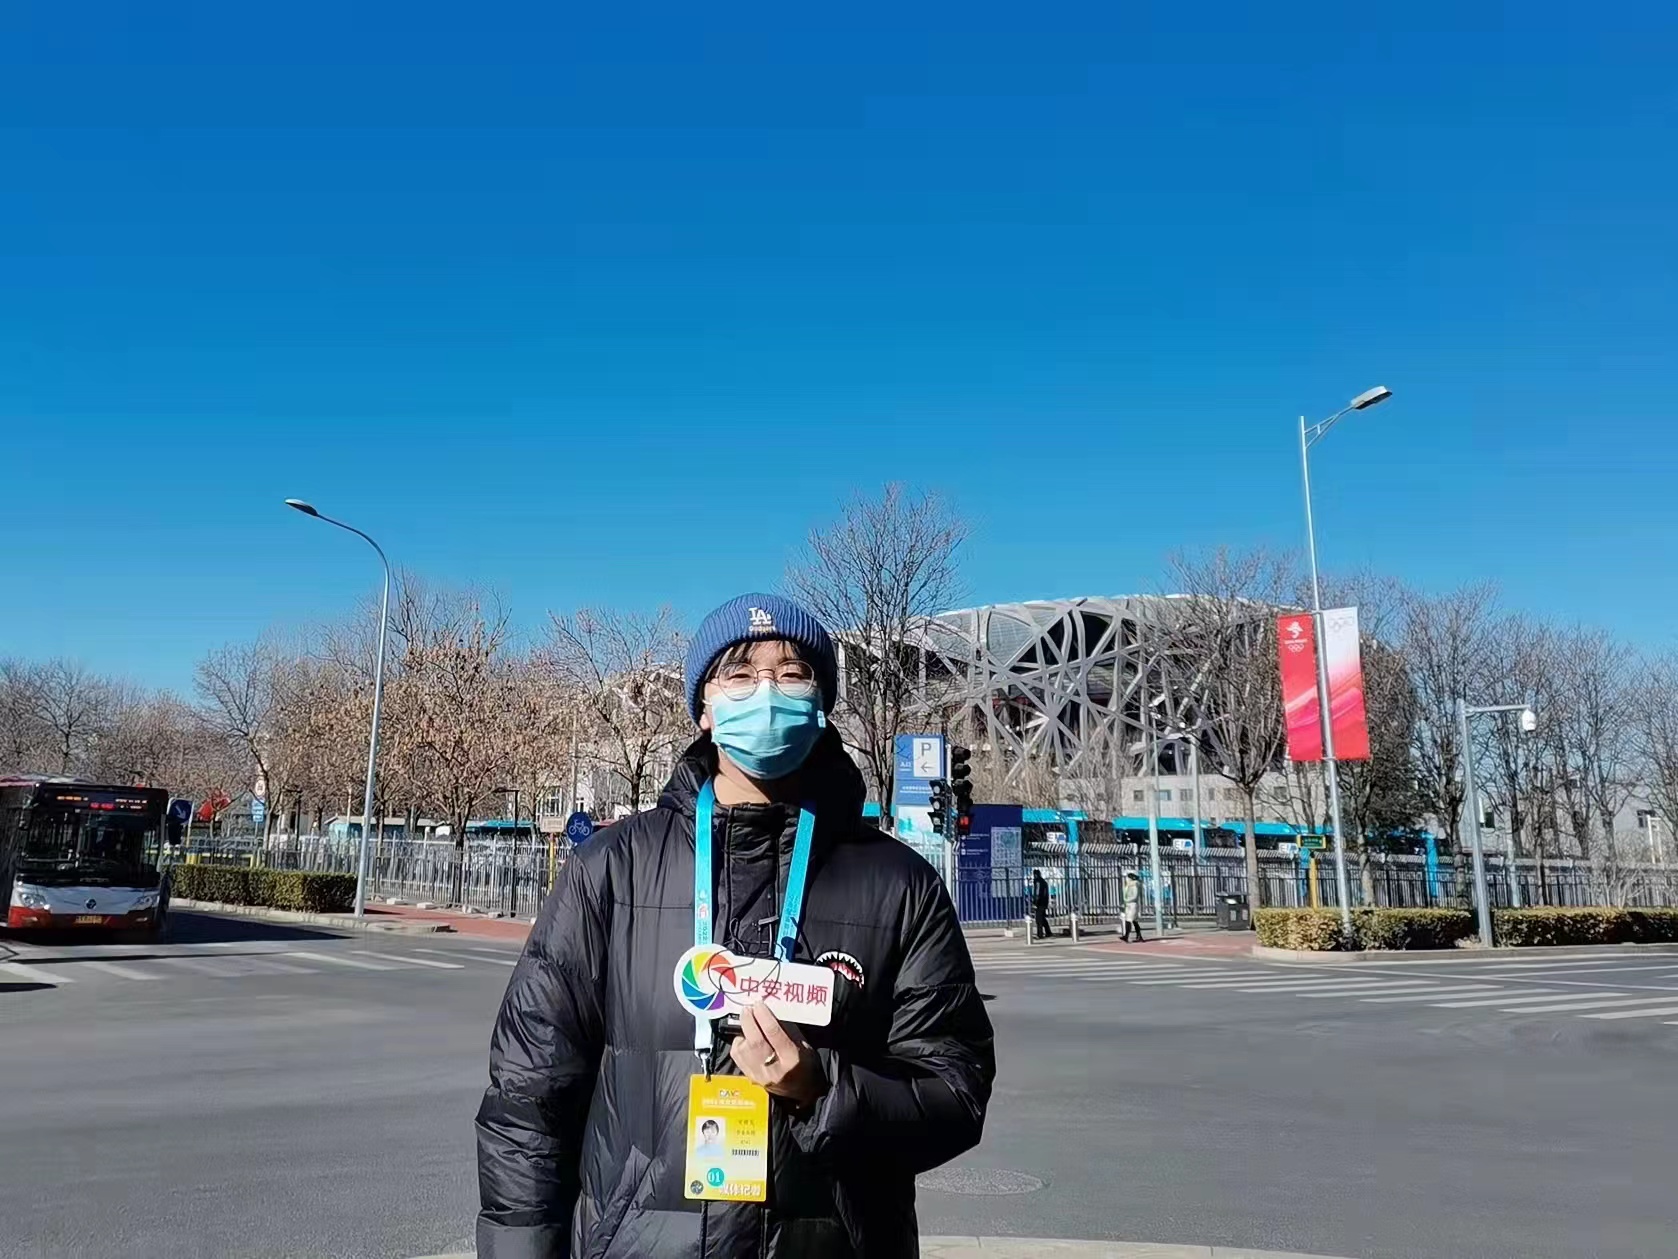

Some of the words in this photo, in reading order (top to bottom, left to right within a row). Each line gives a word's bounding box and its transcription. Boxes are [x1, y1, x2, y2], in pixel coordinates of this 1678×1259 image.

[748, 607, 772, 625] LA
[921, 742, 932, 756] P
[740, 976, 828, 1007] 中安视频
[708, 1171, 721, 1183] 01
